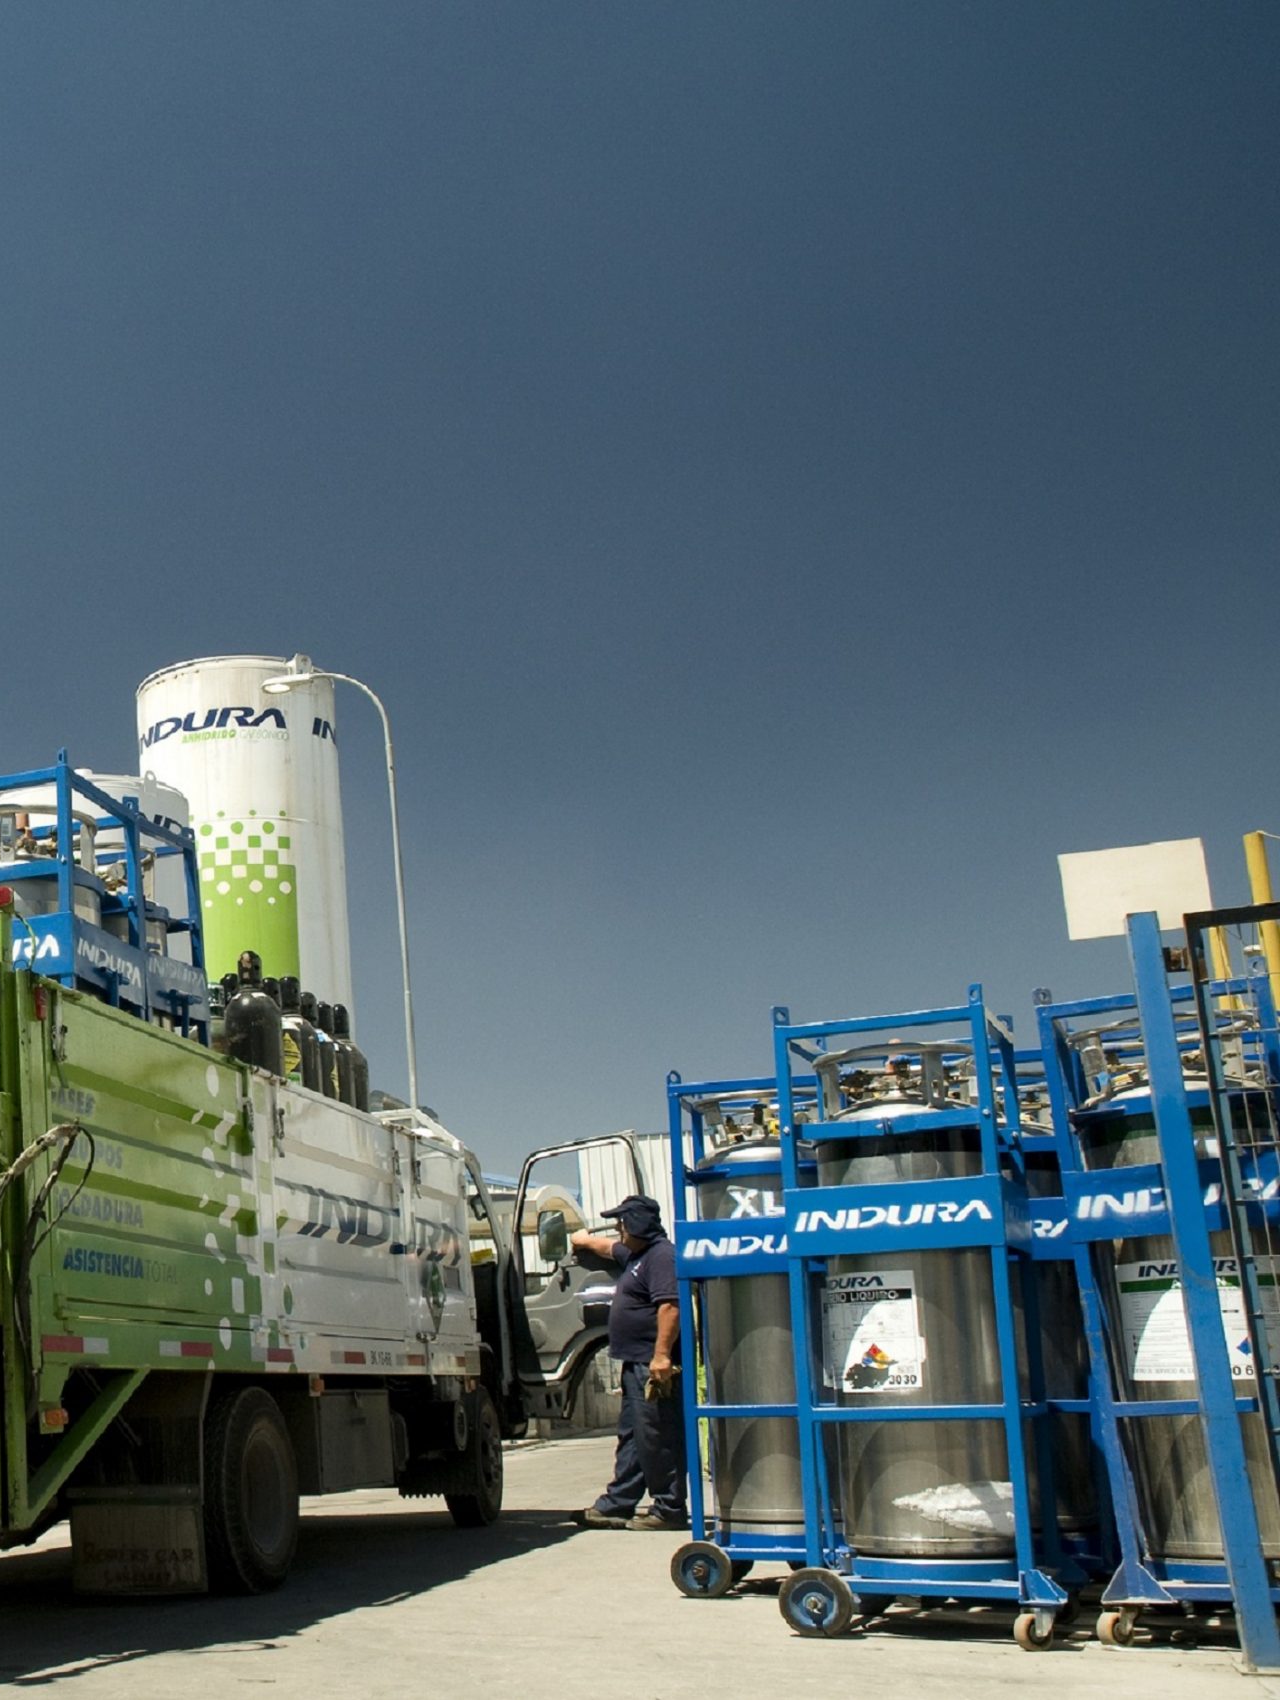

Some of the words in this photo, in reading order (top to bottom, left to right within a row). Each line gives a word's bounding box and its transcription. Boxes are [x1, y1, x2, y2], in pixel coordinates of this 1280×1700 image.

[77, 937, 142, 989] INDURA
[794, 1200, 993, 1233] INDURA
[63, 1248, 144, 1279] ASISTENCIA
